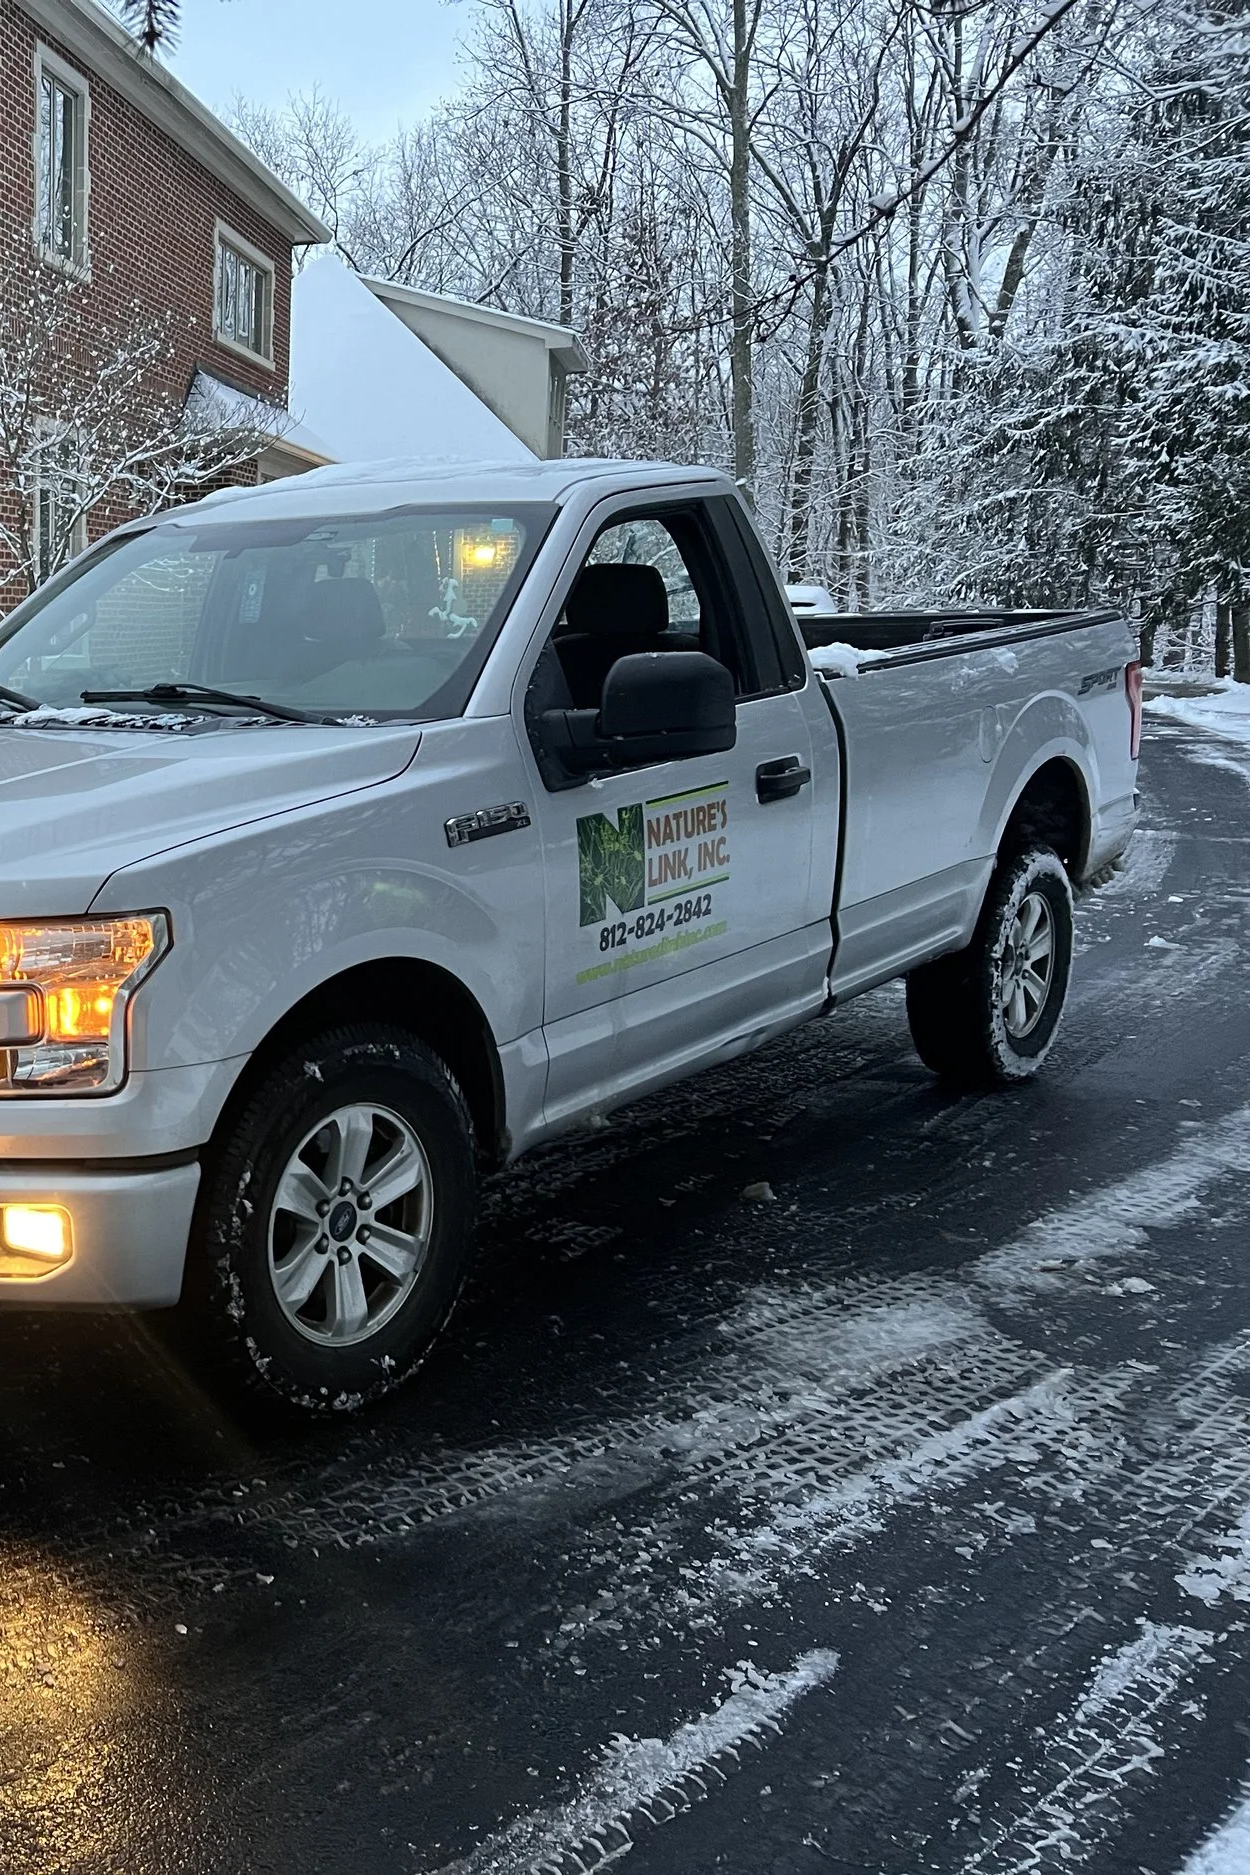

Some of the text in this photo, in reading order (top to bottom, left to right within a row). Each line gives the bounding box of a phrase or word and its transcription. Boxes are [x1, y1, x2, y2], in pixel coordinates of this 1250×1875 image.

[647, 799, 727, 849] NATURE'S
[576, 803, 645, 927] N
[648, 836, 730, 887] LINK, INC.
[599, 893, 712, 952] 812-824-2842
